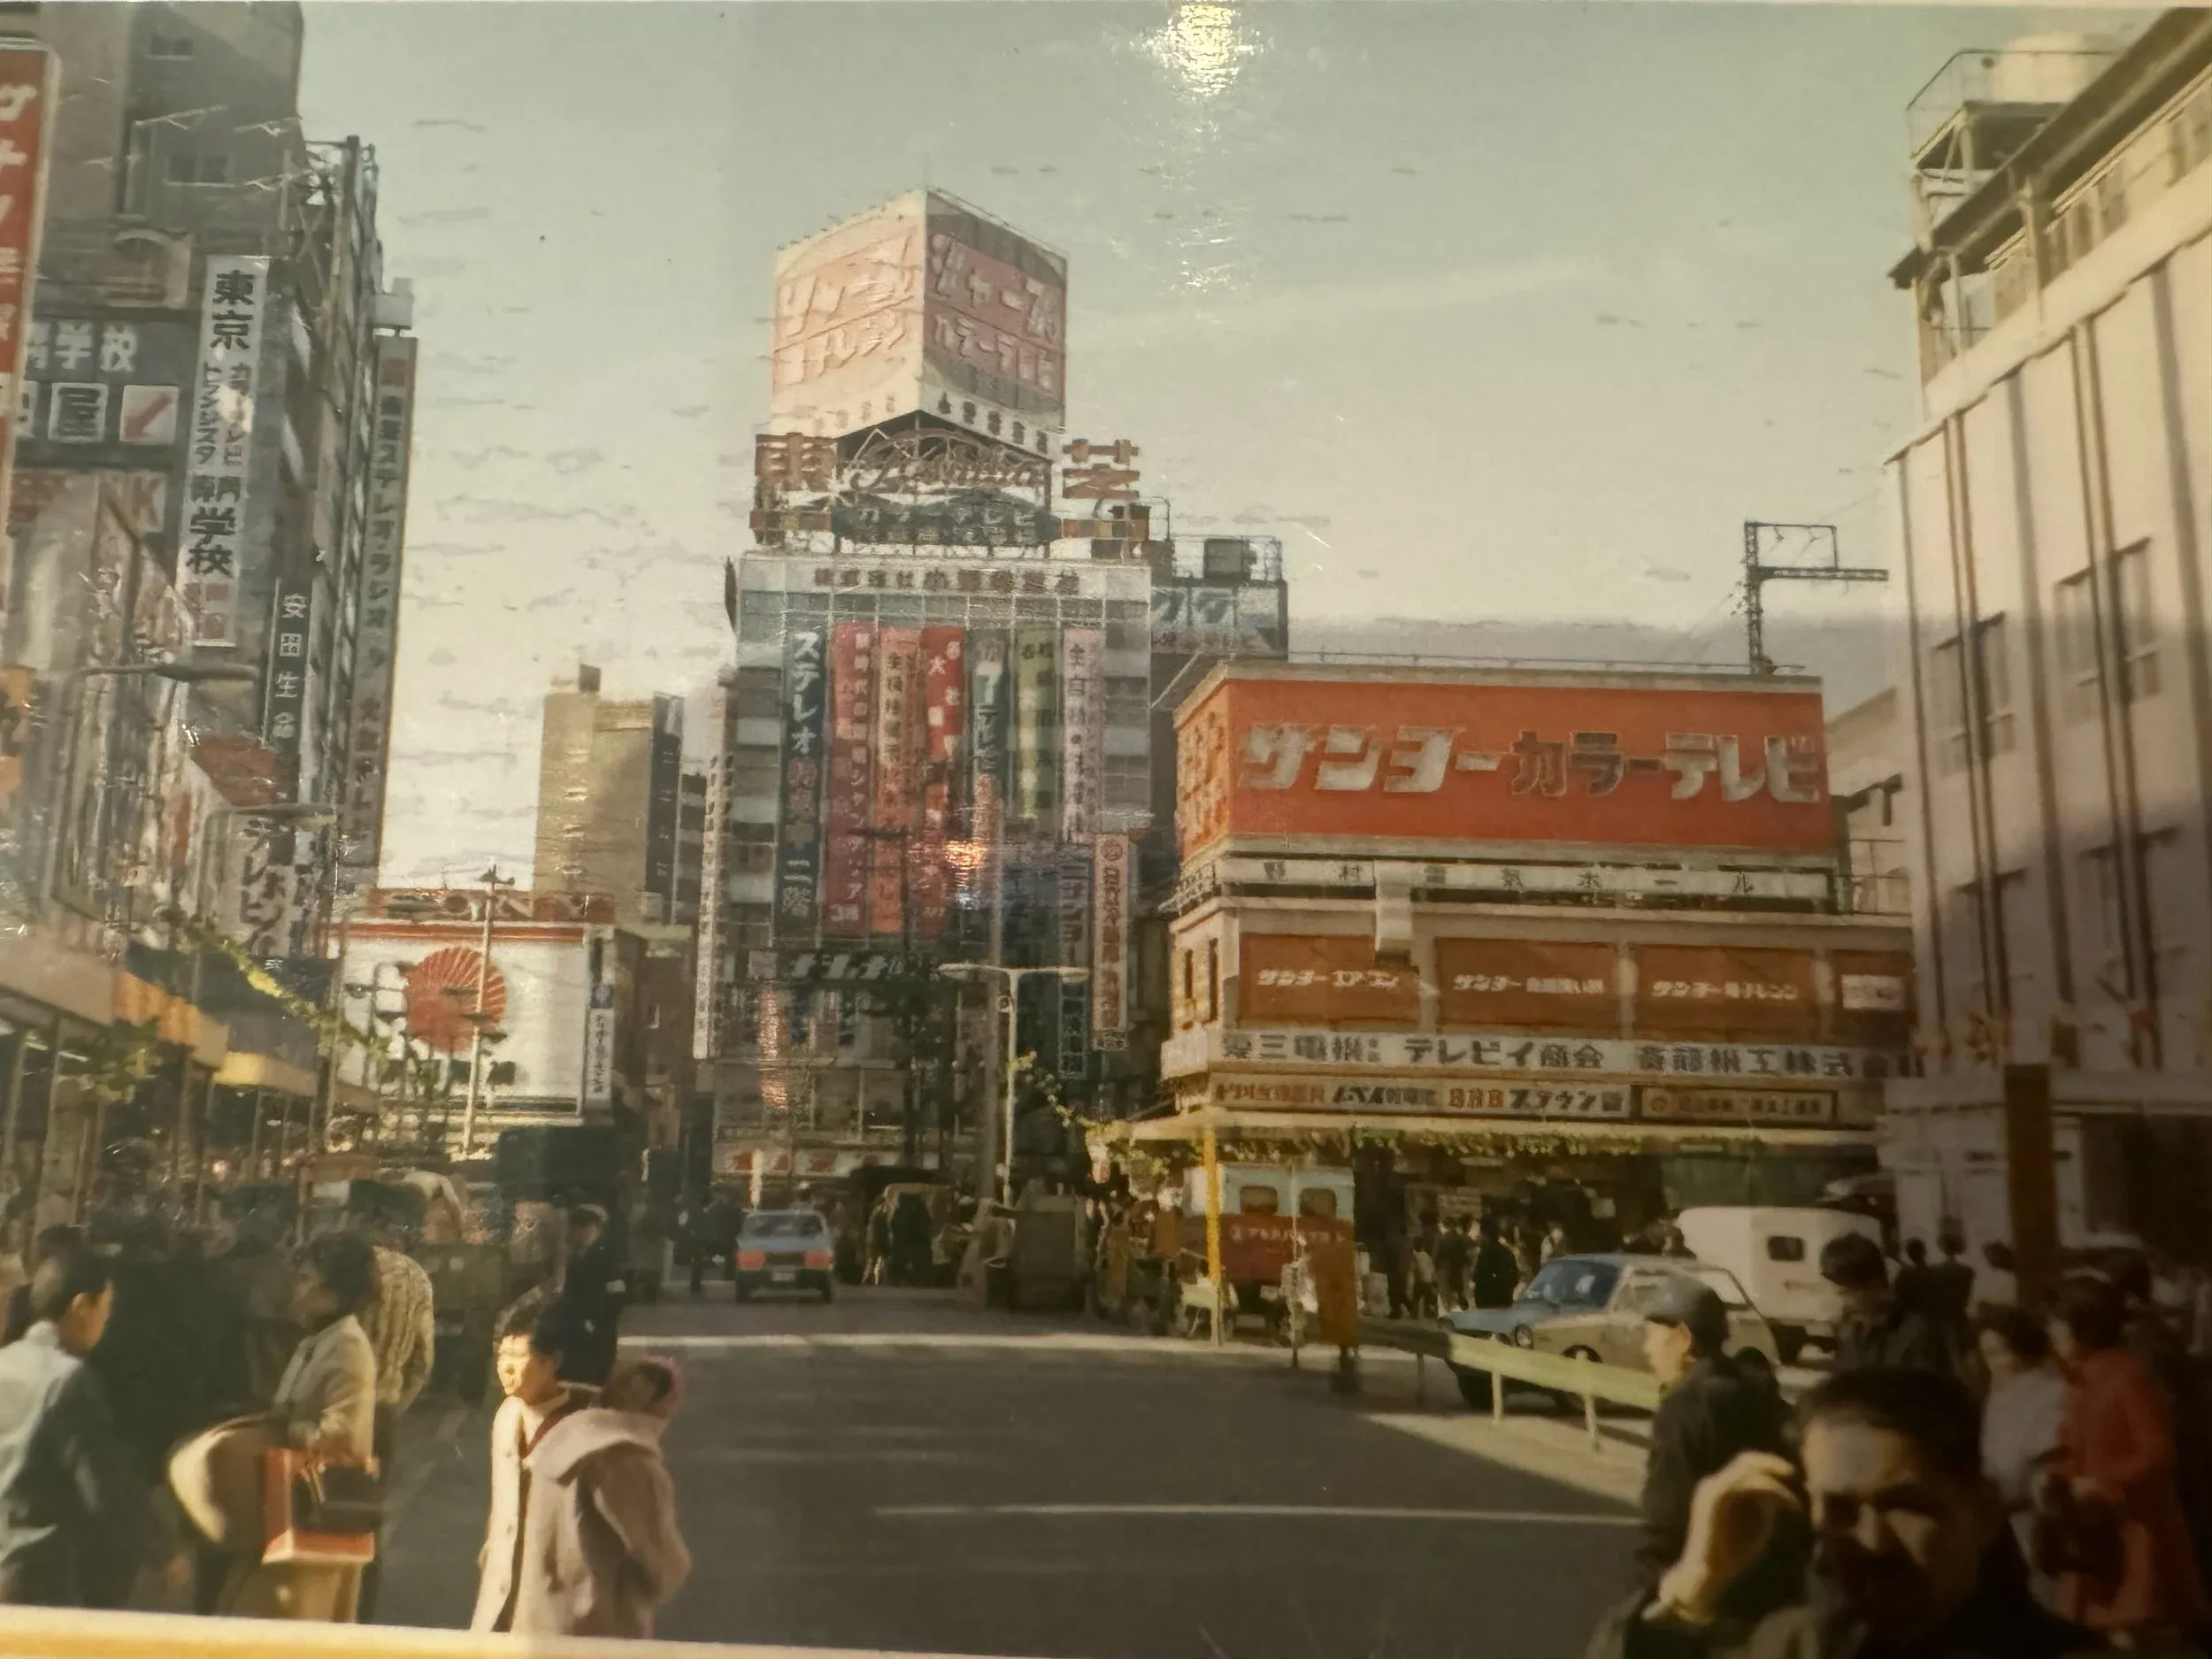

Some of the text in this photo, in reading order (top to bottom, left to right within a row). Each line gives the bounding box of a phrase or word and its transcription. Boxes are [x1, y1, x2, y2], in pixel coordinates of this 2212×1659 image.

[210, 269, 255, 350] 東京
[790, 630, 821, 755] ステレオ
[1241, 718, 1822, 803] サンヨーカラーテレビ
[1403, 1036, 1605, 1069] テレビイ商会
